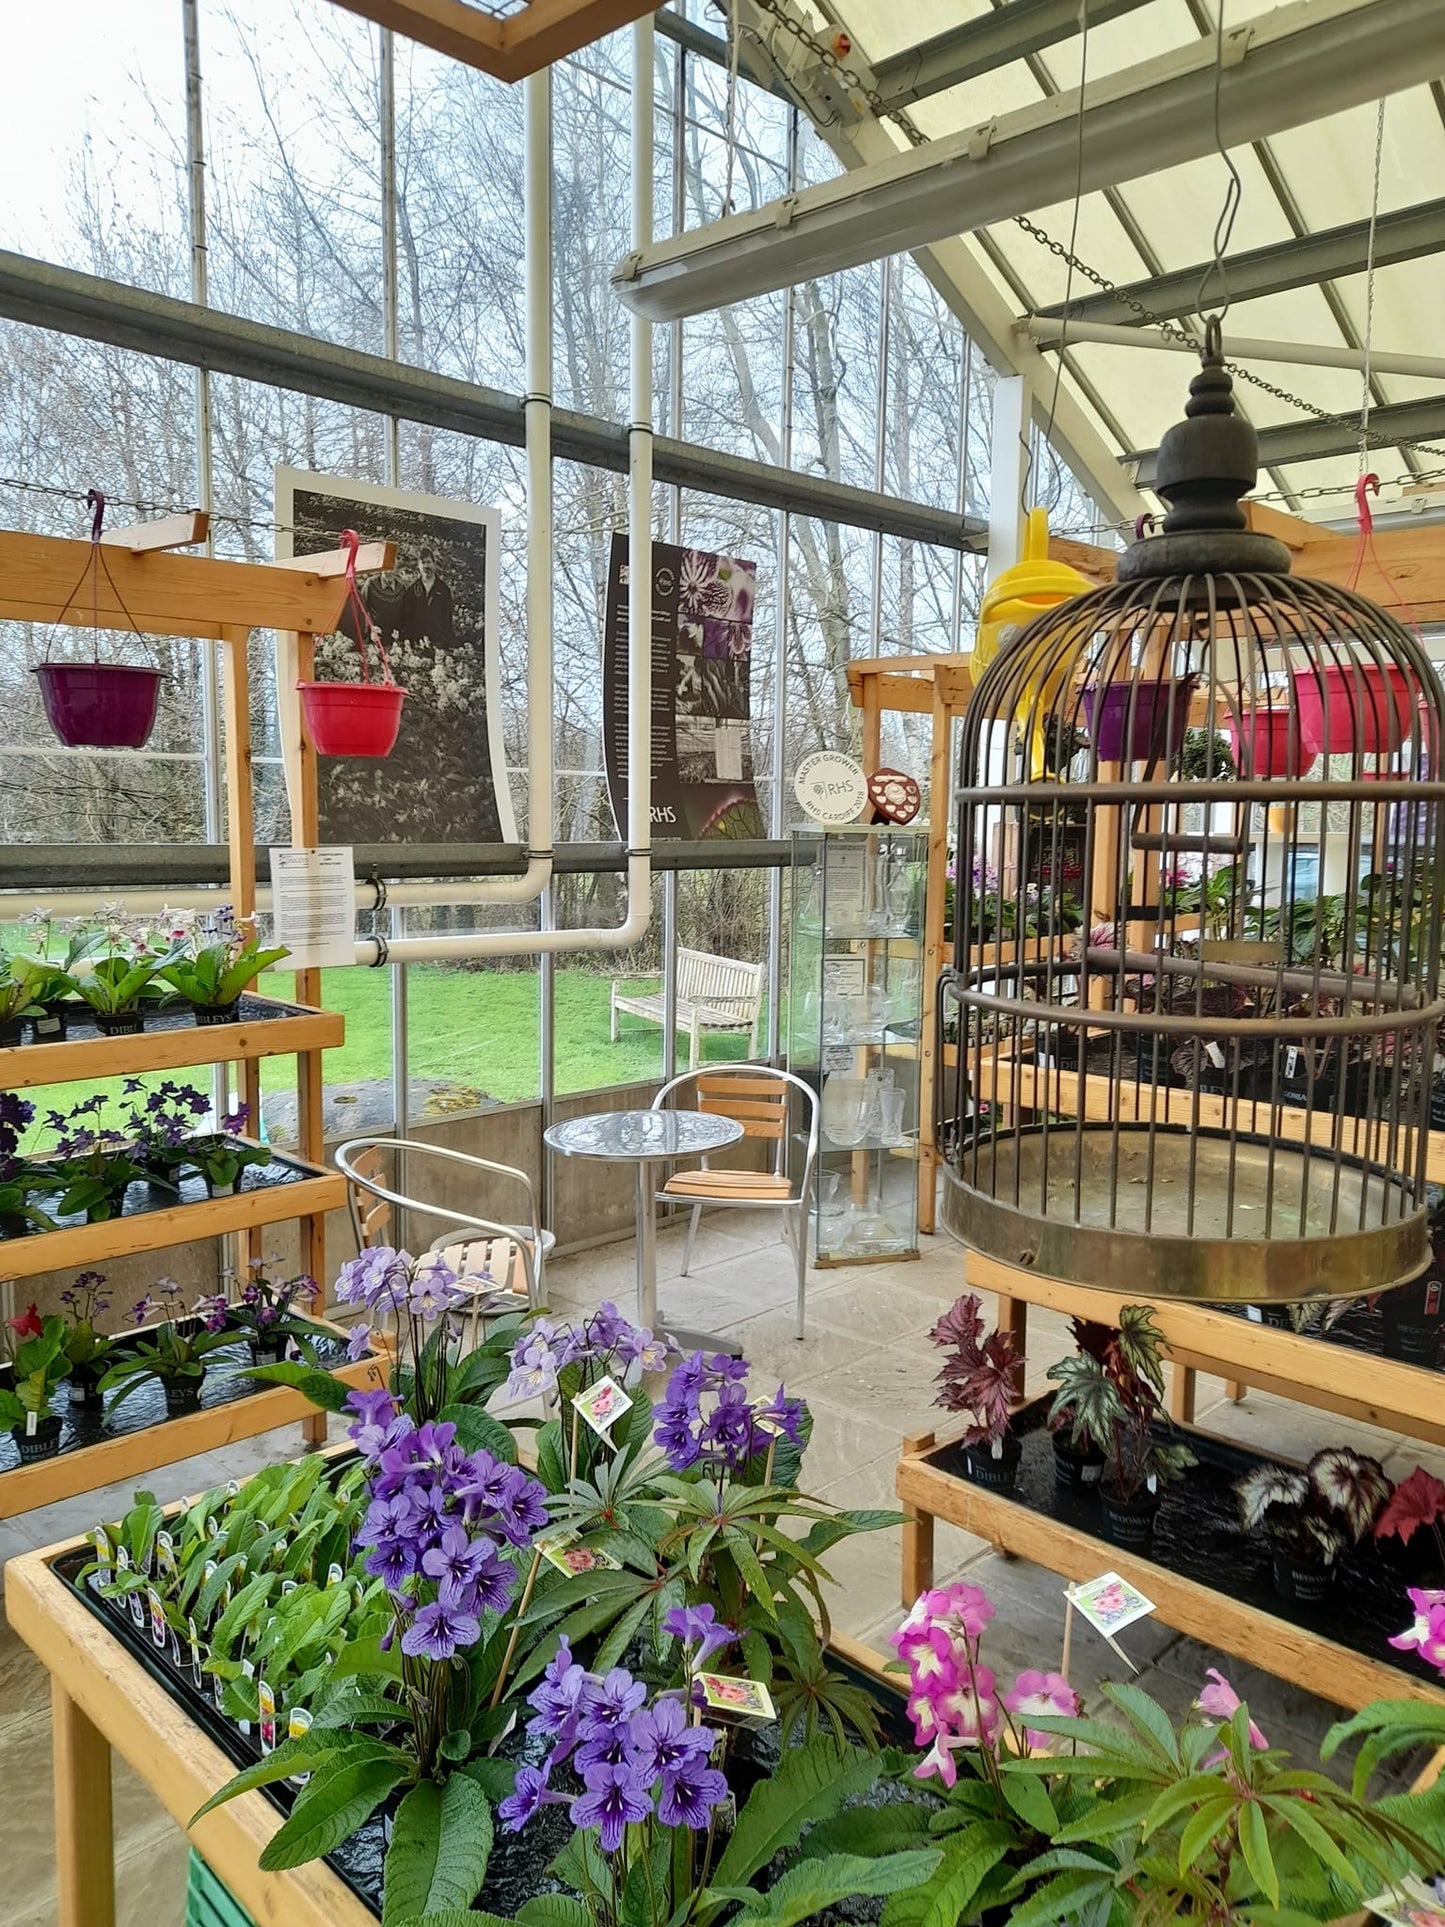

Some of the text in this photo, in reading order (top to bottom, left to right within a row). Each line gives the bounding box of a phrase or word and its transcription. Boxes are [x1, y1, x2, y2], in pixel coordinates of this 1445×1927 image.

[799, 754, 859, 784] MASTER GROWER
[827, 780, 854, 795] RHS
[650, 806, 677, 823] RHS
